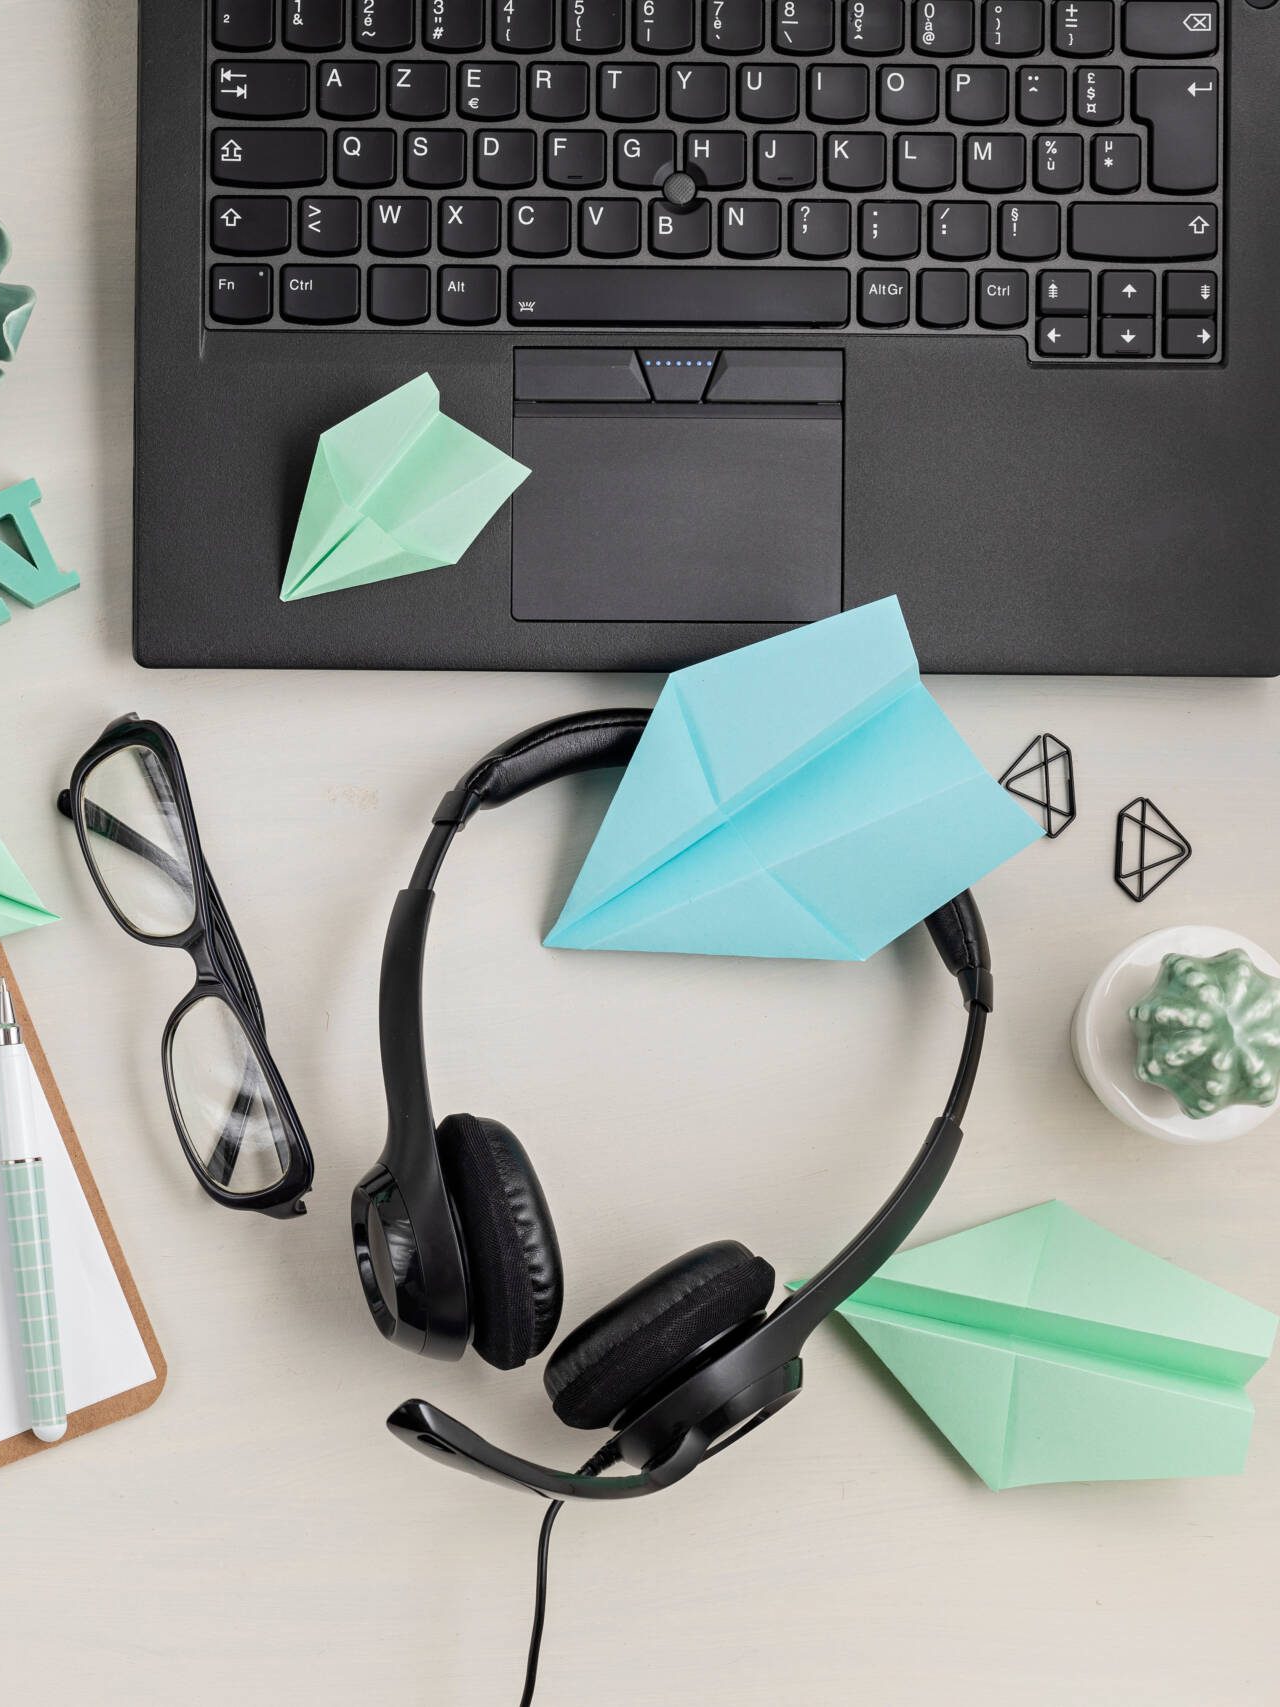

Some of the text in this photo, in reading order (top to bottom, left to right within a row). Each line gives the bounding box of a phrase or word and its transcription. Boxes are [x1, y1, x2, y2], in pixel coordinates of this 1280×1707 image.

[295, 0, 300, 12] 1
[364, 0, 374, 13] 2
[434, 0, 443, 14] 3
[504, 0, 514, 14] 4
[575, 0, 584, 14] 5
[644, 0, 654, 15] 6
[714, 1, 724, 14] 7
[785, 2, 794, 16] 8
[854, 3, 864, 18] 9
[924, 3, 934, 18] 0
[1066, 4, 1078, 16] +
[293, 14, 303, 25] &
[364, 14, 372, 26] é
[855, 19, 862, 32] ç
[1066, 19, 1077, 27] =
[433, 27, 444, 39] #
[923, 30, 935, 44] @
[327, 69, 342, 86] A
[397, 69, 411, 87] Z
[468, 69, 481, 87] E
[537, 70, 551, 88] R
[608, 71, 622, 88] T
[677, 71, 692, 89] Y
[748, 72, 761, 90] U
[887, 73, 904, 91] O
[957, 74, 970, 92] P
[1088, 73, 1095, 83] £
[1087, 87, 1095, 100] $
[468, 98, 479, 108] €
[343, 137, 360, 156] Q
[414, 137, 427, 156] S
[484, 138, 499, 155] D
[554, 138, 567, 156] F
[624, 139, 640, 157] G
[695, 140, 709, 157] H
[765, 140, 775, 158] J
[835, 140, 848, 158] K
[905, 141, 916, 159] L
[974, 142, 991, 160] M
[1045, 141, 1057, 154] %
[1048, 158, 1054, 170] ù
[379, 205, 401, 223] W
[448, 206, 462, 224] X
[518, 206, 534, 225] C
[589, 207, 603, 225] V
[729, 208, 743, 225] N
[801, 206, 810, 221] ?
[1011, 208, 1018, 221] §
[659, 216, 673, 234] B
[219, 279, 234, 289] Fn
[290, 279, 312, 290] Ctrl
[448, 281, 464, 292] Alt
[987, 285, 1009, 296] Ctrl
